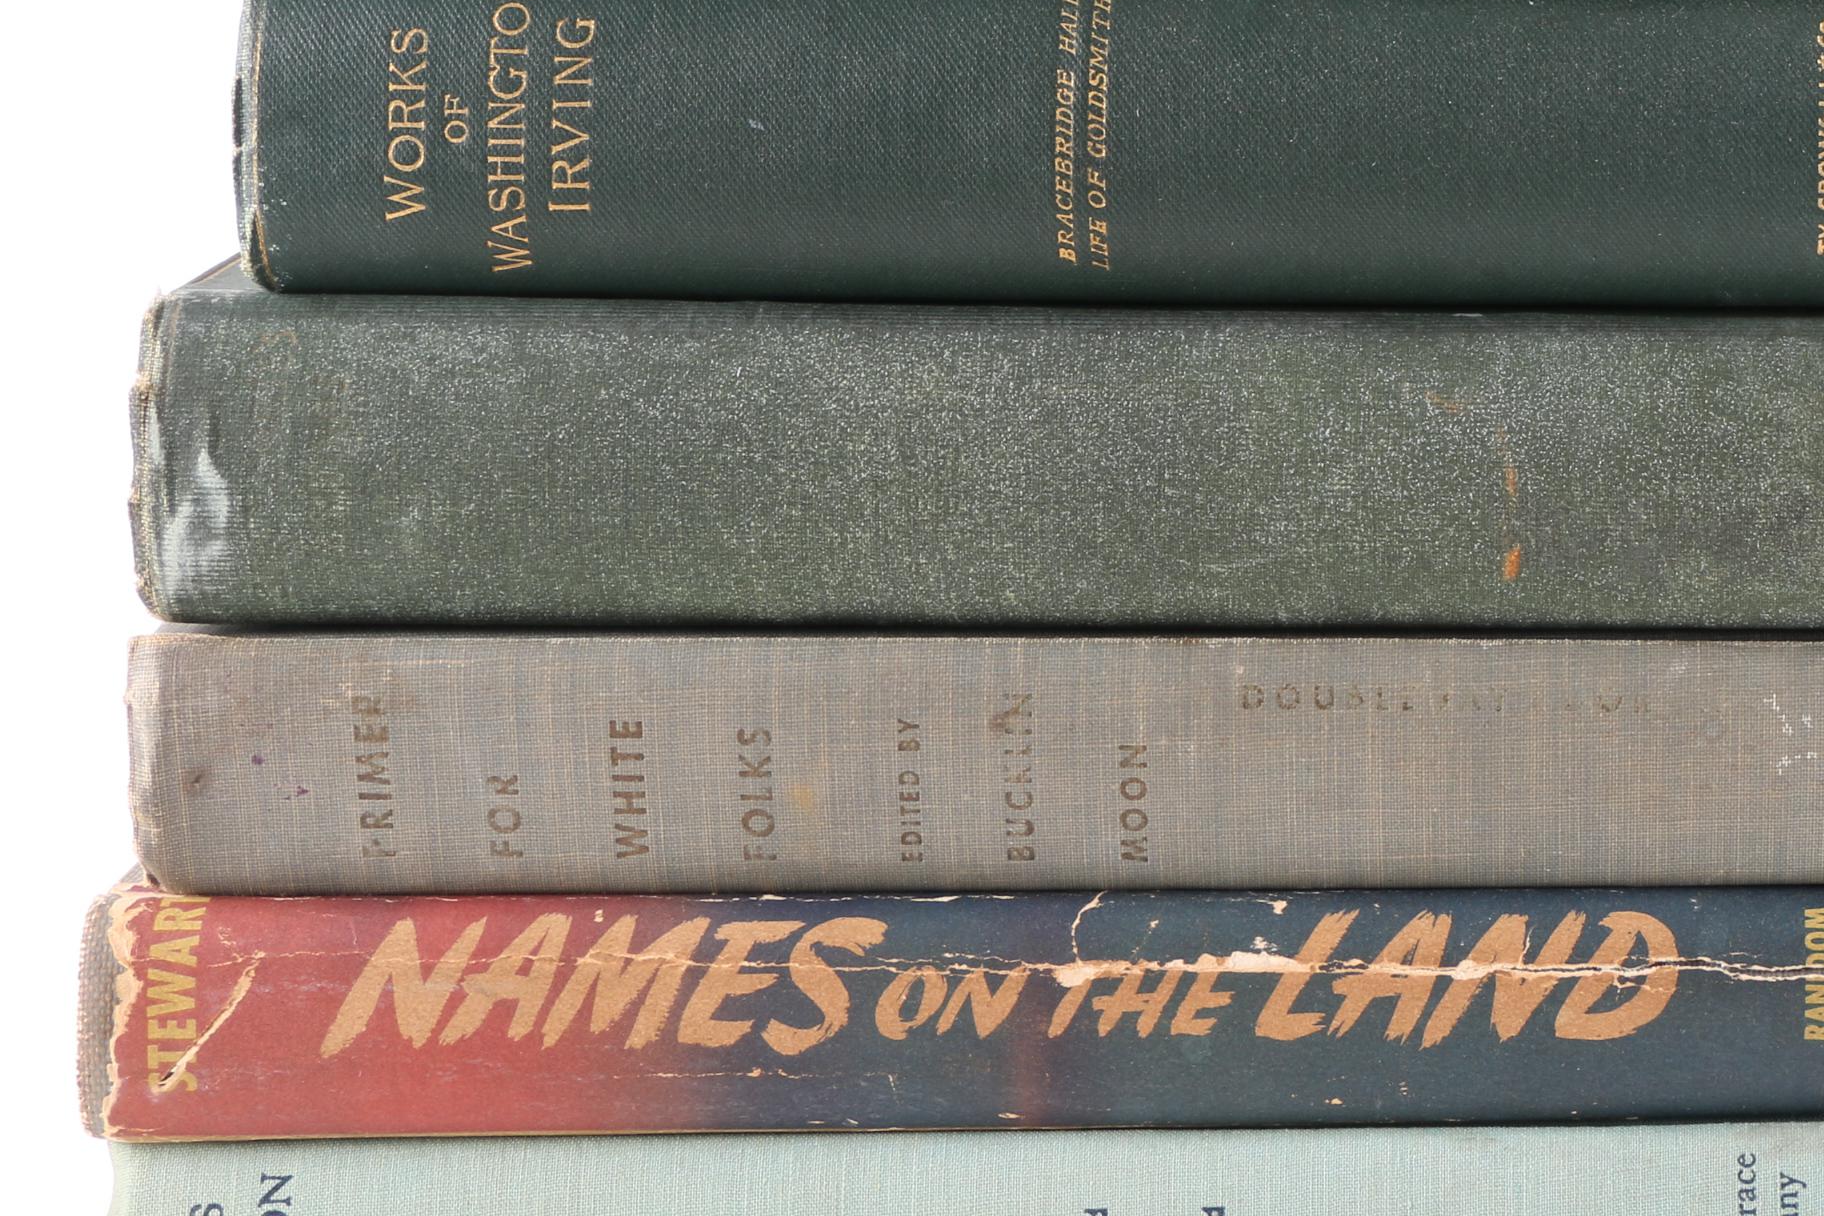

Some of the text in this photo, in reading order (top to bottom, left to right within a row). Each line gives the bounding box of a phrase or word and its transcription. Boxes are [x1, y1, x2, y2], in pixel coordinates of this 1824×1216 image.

[383, 27, 428, 221] WORKS
[444, 94, 469, 144] OF
[548, 17, 595, 212] IRVING
[1055, 69, 1077, 265] BRACEBRIDGE
[1088, 167, 1107, 209] OF
[1088, 216, 1110, 270] LIFE
[487, 774, 523, 858] FOR
[609, 720, 650, 859] WHITE
[737, 727, 777, 861] FOLKS
[897, 718, 923, 862] EDITED BY
[1118, 744, 1149, 862] MOON
[320, 910, 1681, 1059] NAMES ON THE LAND
